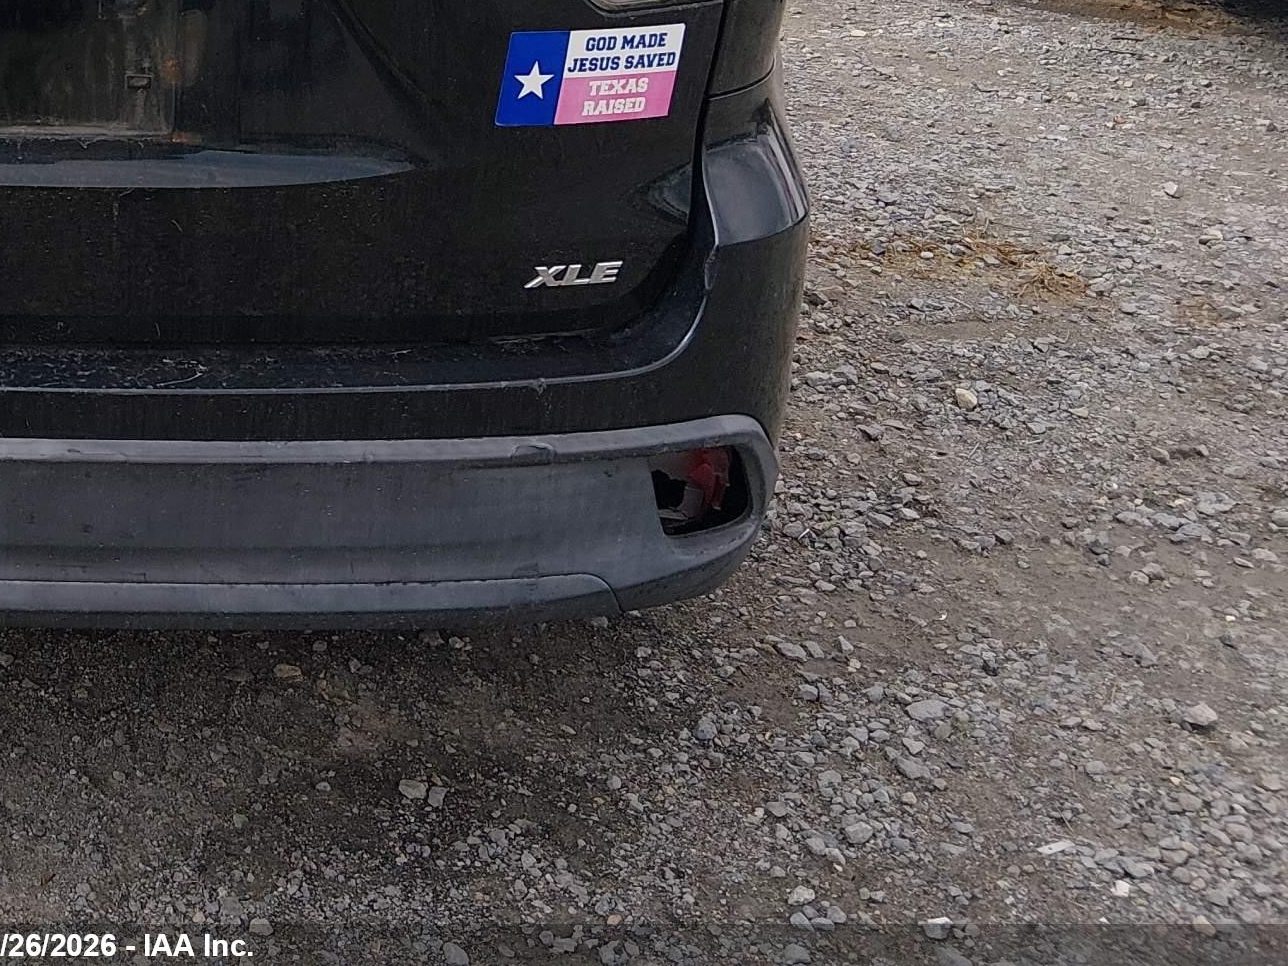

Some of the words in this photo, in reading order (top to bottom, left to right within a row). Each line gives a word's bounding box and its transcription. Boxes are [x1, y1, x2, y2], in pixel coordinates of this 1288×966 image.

[585, 36, 617, 52] GOD
[620, 33, 668, 51] MADE
[567, 55, 620, 73] JESUS
[623, 52, 676, 69] SAVED
[588, 78, 649, 96] TEXAS
[581, 97, 646, 116] RAISED
[523, 260, 624, 289] XLE
